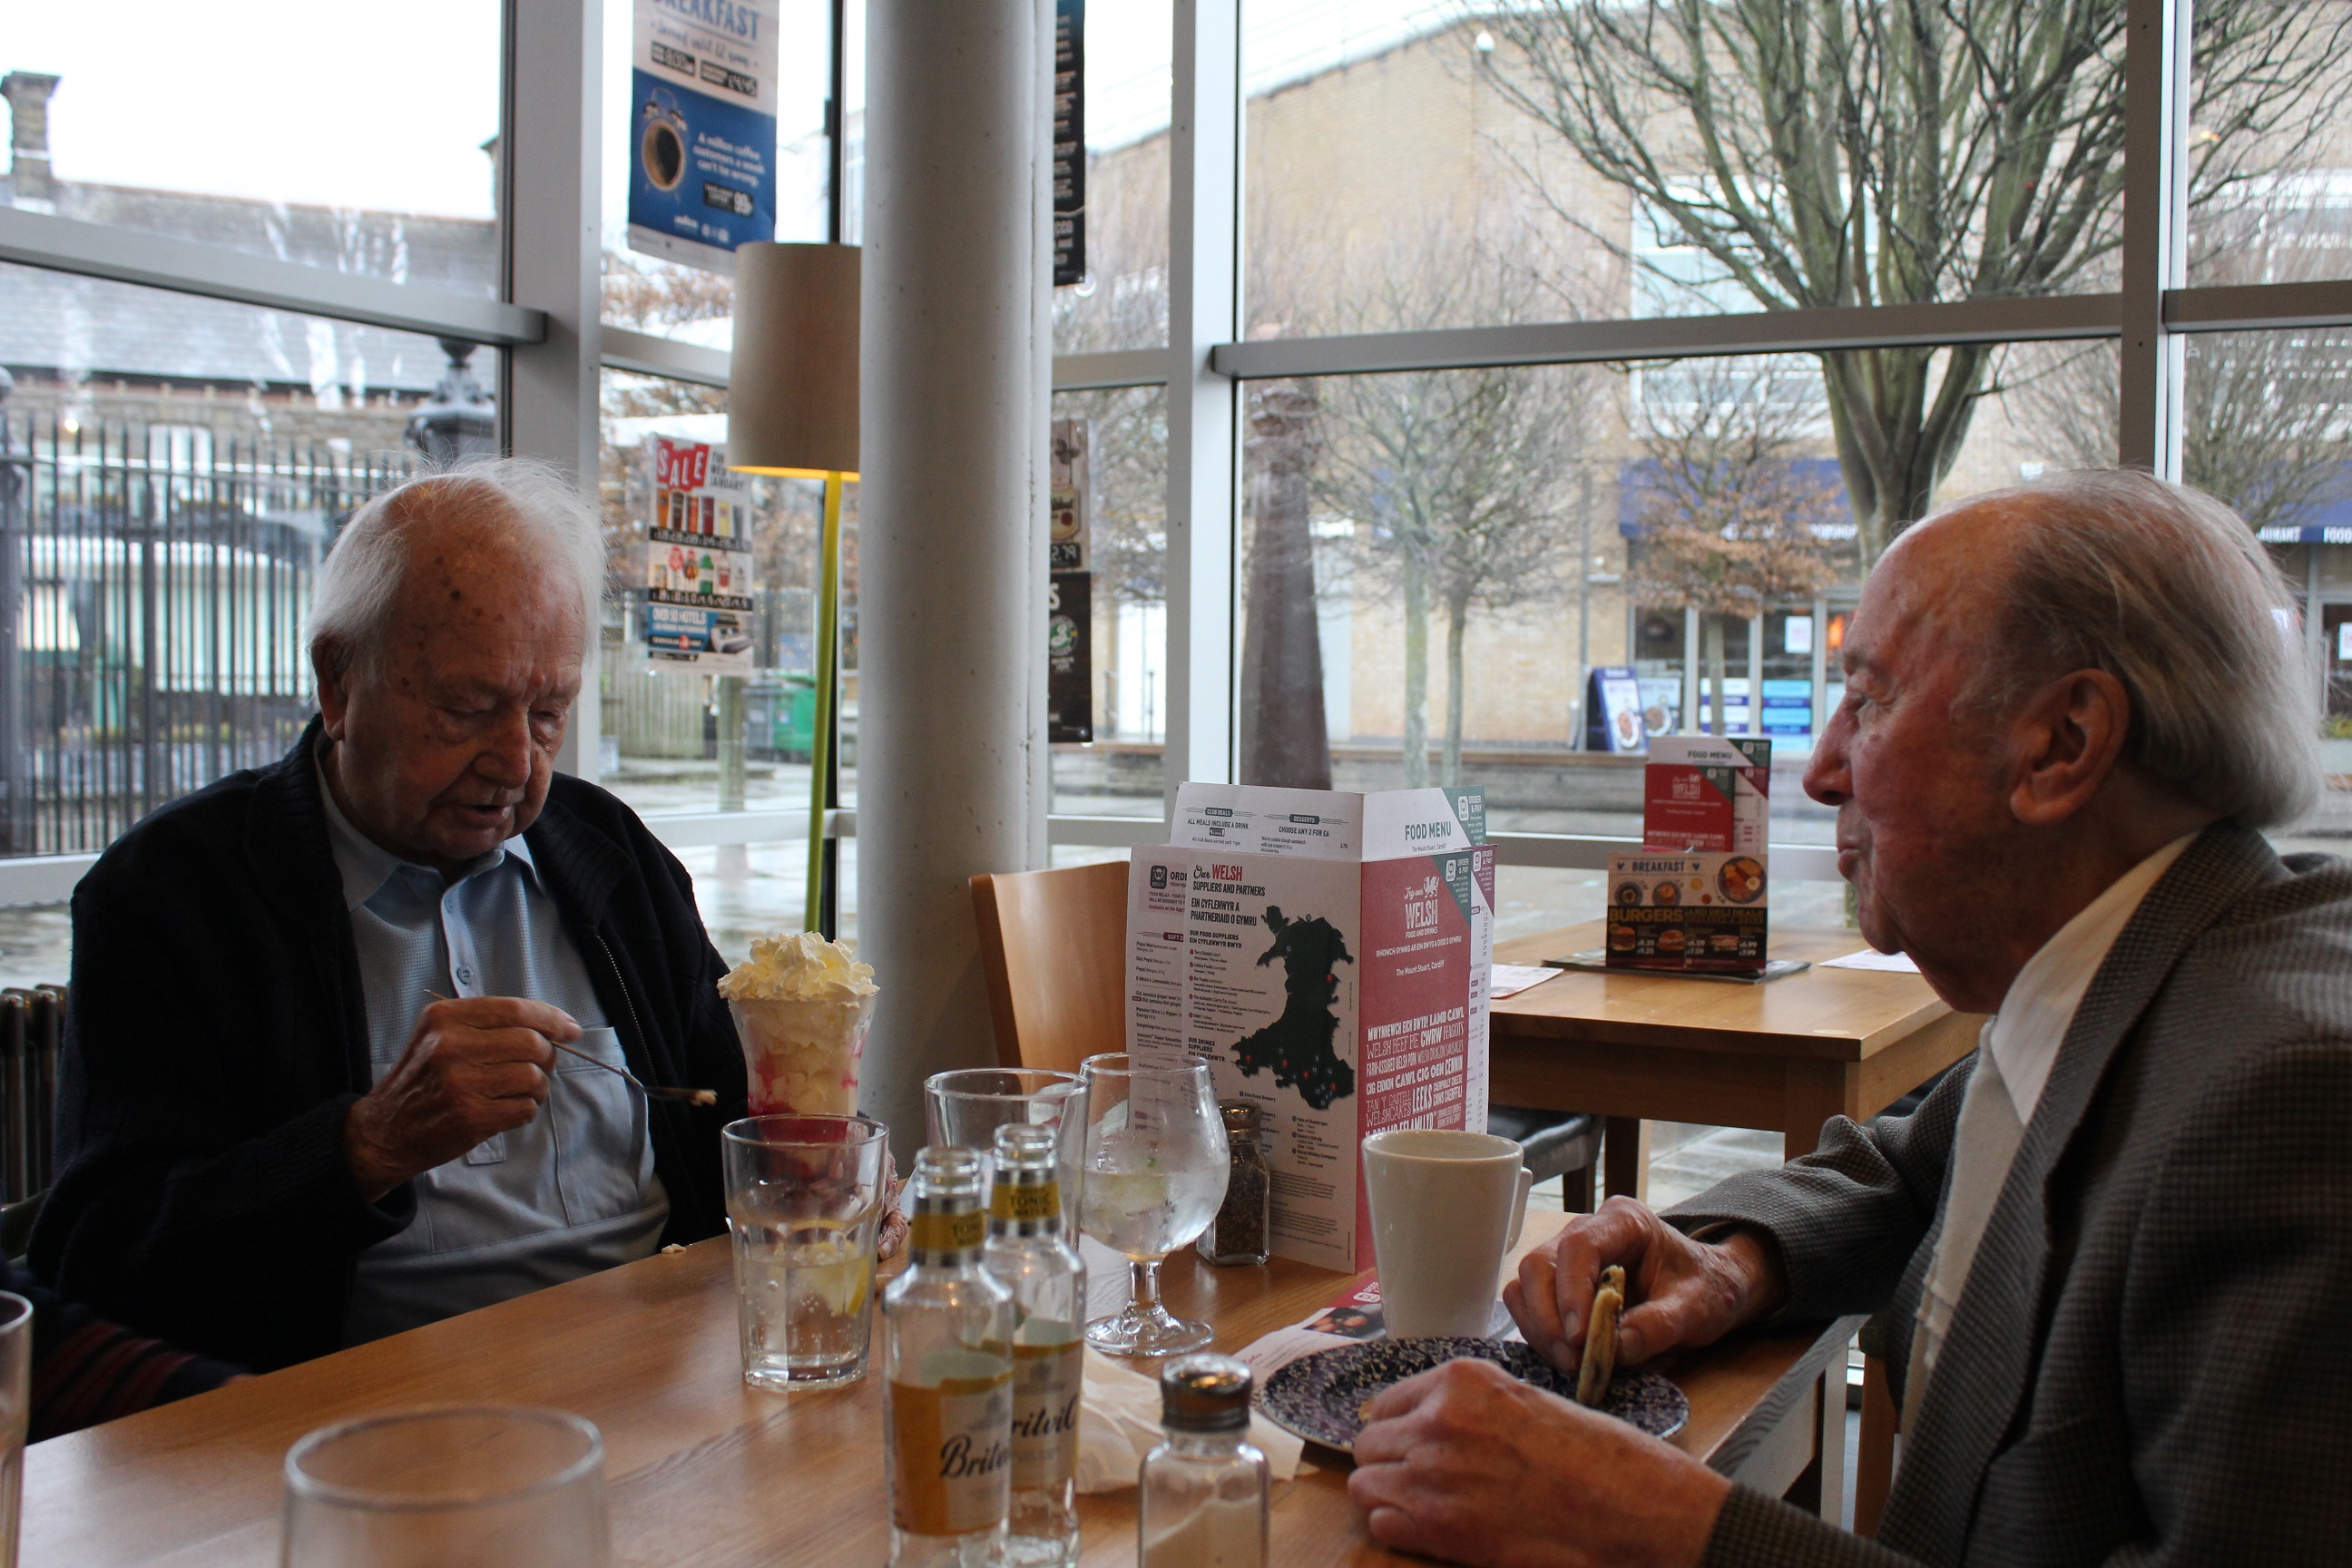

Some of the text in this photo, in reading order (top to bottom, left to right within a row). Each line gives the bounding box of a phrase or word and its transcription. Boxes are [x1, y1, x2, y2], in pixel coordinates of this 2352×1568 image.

[657, 449, 704, 489] SALE
[1688, 751, 1707, 759] FOOD
[1469, 795, 1481, 803] ORDER
[1211, 820, 1230, 828] INCLUDE
[1278, 826, 1297, 835] CHOOSE
[1405, 824, 1427, 841] FOOD
[1429, 821, 1451, 838] MENU
[1194, 864, 1243, 881] Our WELSH
[1632, 861, 1685, 872] BREAKFAST
[1170, 872, 1187, 881] ORD
[1193, 881, 1265, 896] SUPPLIERS AND PARTNERS
[1191, 898, 1240, 911] EIN CYFLENWYR A
[1191, 910, 1257, 926] PHARTNERIAID O GYMRU
[1405, 900, 1438, 929] WELSH
[1608, 908, 1684, 923] BURGERS
[1424, 927, 1438, 935] DRINKS
[1198, 938, 1226, 947] CYFLENWYR
[1376, 948, 1395, 957] RHOWCH
[1396, 945, 1411, 954] GYNNIG
[1424, 941, 1434, 949] BWYD
[1449, 936, 1461, 944] GYMRU
[1404, 966, 1417, 975] Mount
[1418, 963, 1431, 973] Stuart,
[1431, 960, 1444, 969] Cardiff
[1368, 1022, 1402, 1041] MWYNHEWCH
[1402, 1019, 1413, 1034] EICH
[1430, 1011, 1447, 1026] LAMB
[1447, 1006, 1464, 1021] CAWL
[1188, 1044, 1213, 1052] SUPPLIERS
[1366, 1039, 1391, 1059] WELSH
[1393, 1036, 1409, 1054] BEEF
[1410, 1033, 1419, 1049] PIE
[1421, 1026, 1442, 1048] CWRW
[1366, 1054, 1463, 1095] CIG EIDION CAWL CIG OEN CENNIN
[1366, 1098, 1379, 1112] TAN
[1382, 1096, 1386, 1108] Y
[1389, 1090, 1411, 1107] CASTELL
[1413, 1084, 1432, 1114] LEEKS
[1366, 1102, 1412, 1127] WELSHCAKES
[1433, 1091, 1444, 1107] CAWS
[1009, 1194, 1053, 1209] TONIC
